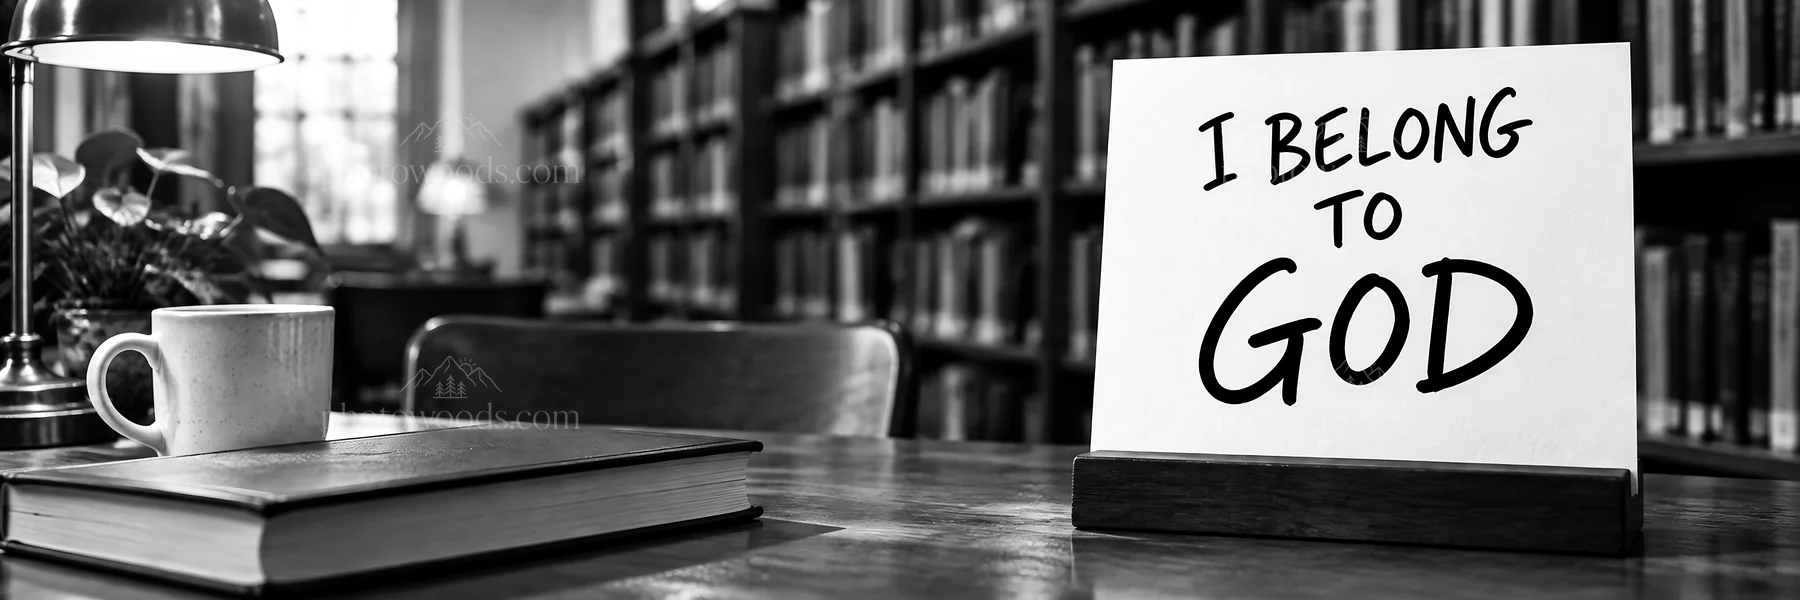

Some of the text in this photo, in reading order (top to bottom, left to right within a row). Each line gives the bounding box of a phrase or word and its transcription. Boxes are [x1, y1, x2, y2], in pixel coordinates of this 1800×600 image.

[1198, 86, 1534, 192] I BELONG
[1313, 189, 1403, 249] TO
[1198, 256, 1534, 407] GOD
